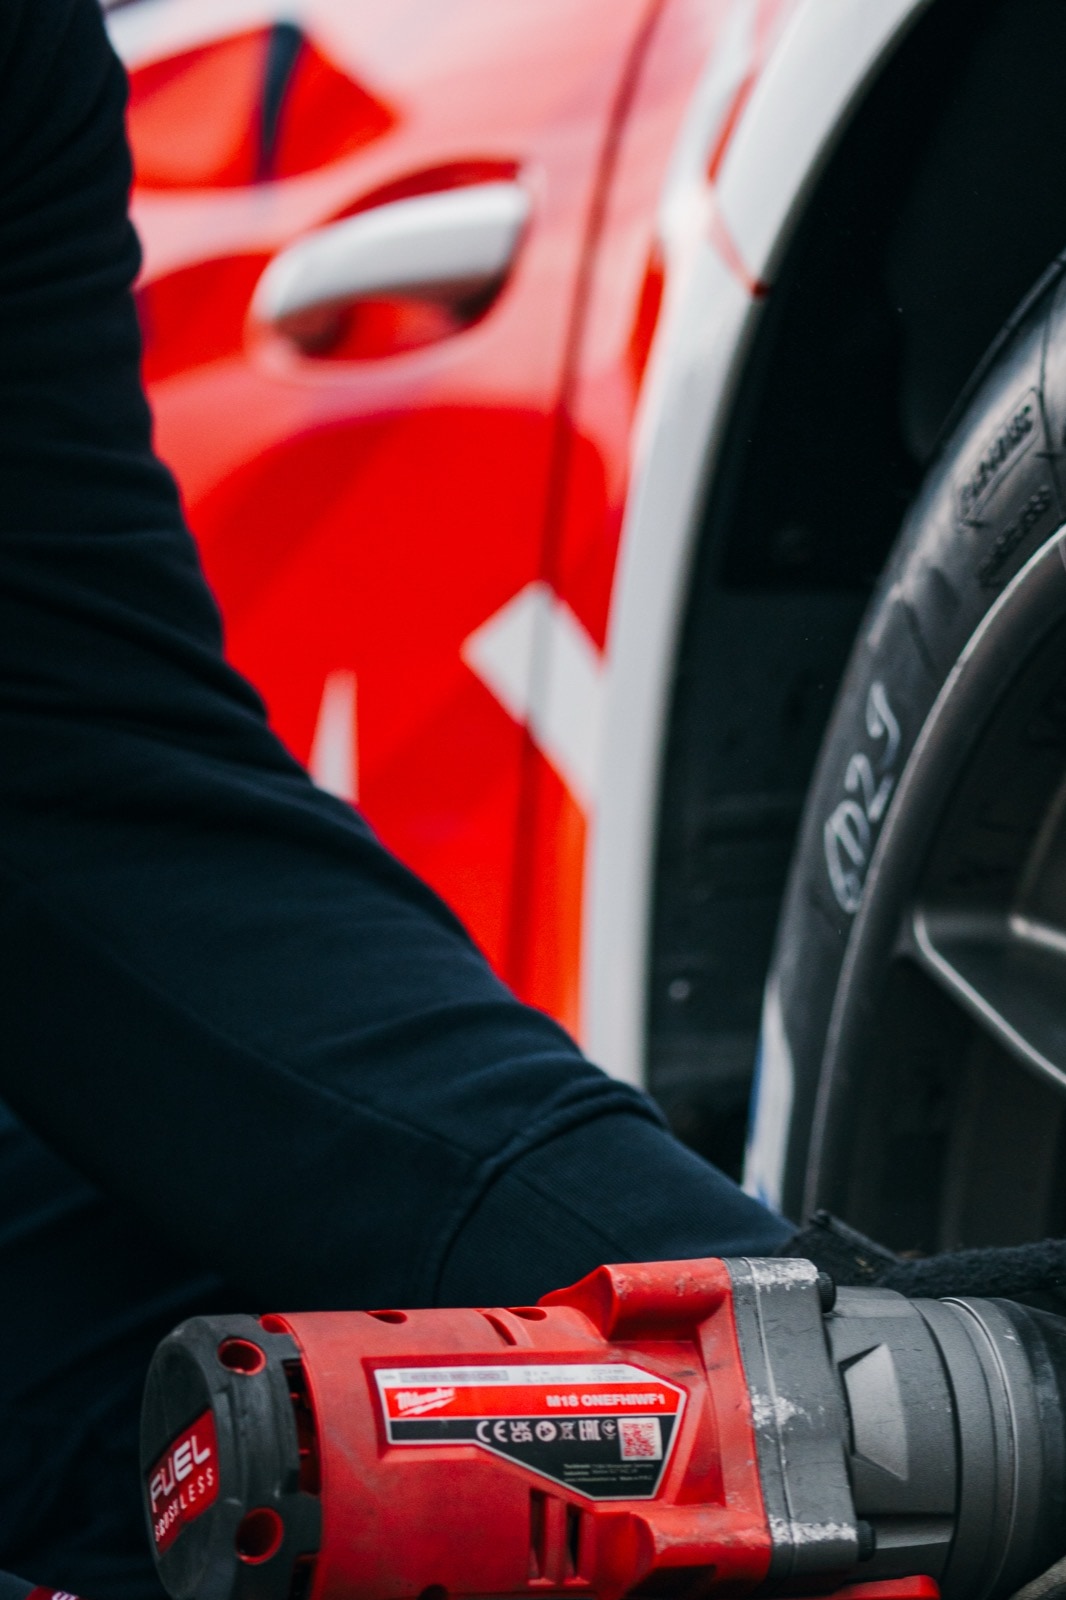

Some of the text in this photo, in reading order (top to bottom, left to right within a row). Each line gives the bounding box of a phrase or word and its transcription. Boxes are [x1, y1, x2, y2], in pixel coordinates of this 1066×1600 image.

[546, 1394, 579, 1408] M18
[149, 1435, 211, 1513] FUEL
[154, 1466, 214, 1542] BRUSHLESS
